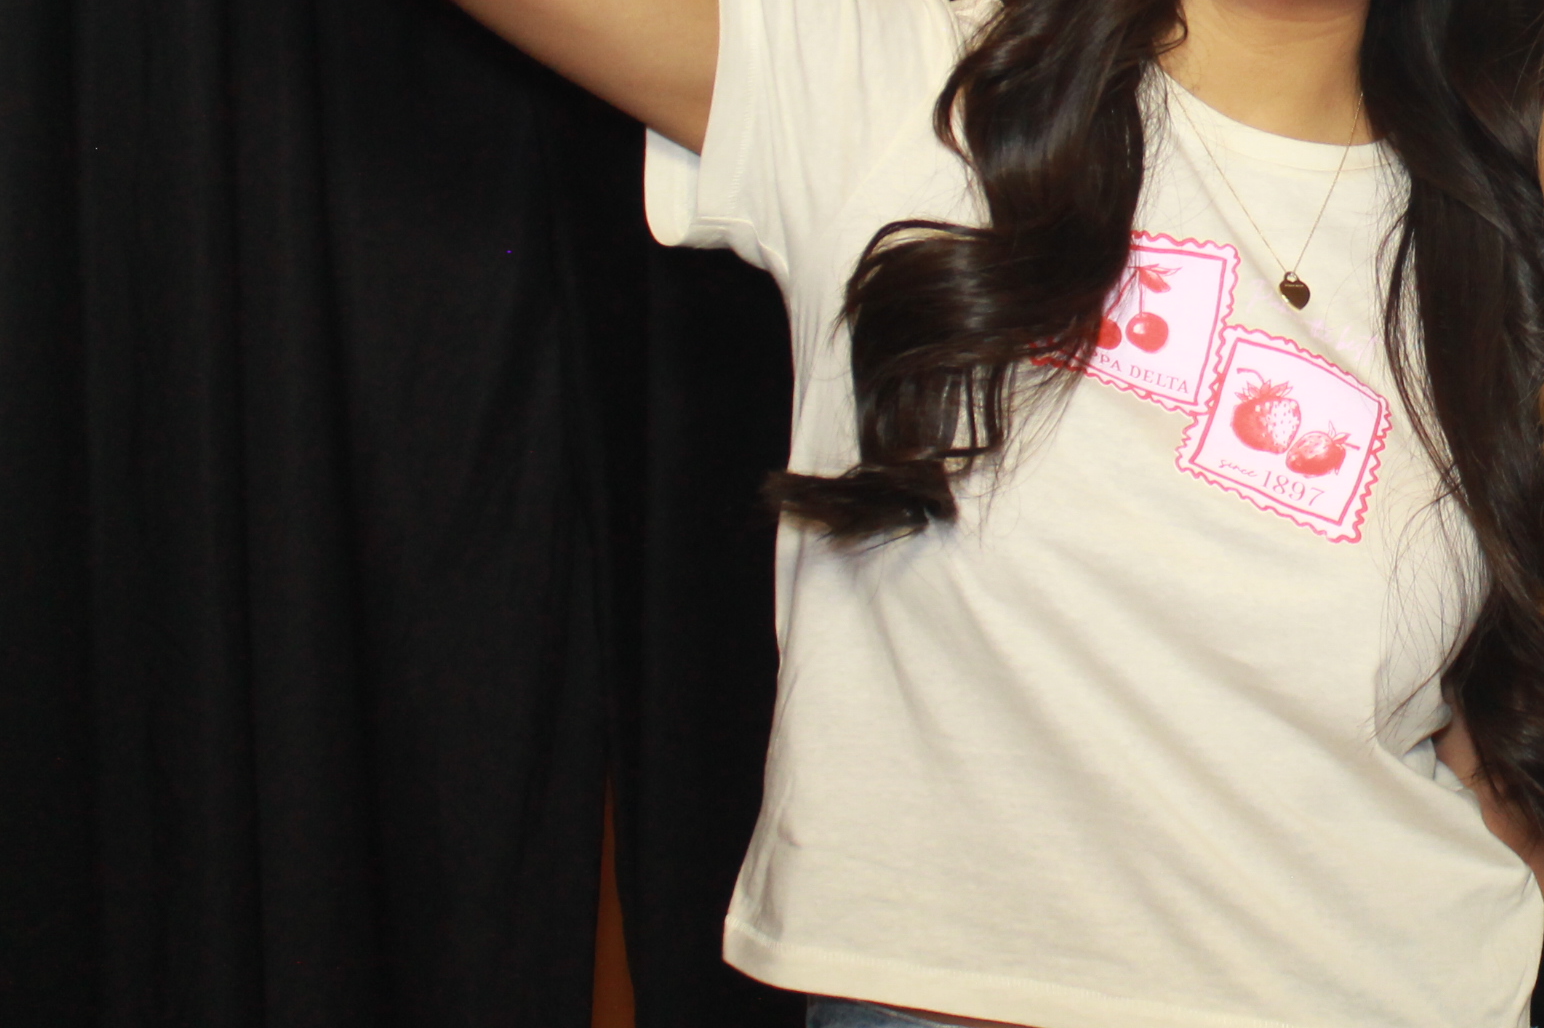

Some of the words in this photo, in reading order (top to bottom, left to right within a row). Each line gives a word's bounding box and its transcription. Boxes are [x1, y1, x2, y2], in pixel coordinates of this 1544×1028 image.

[1129, 364, 1190, 395] DELTA
[1218, 458, 1259, 478] since
[1261, 469, 1326, 507] 1897
